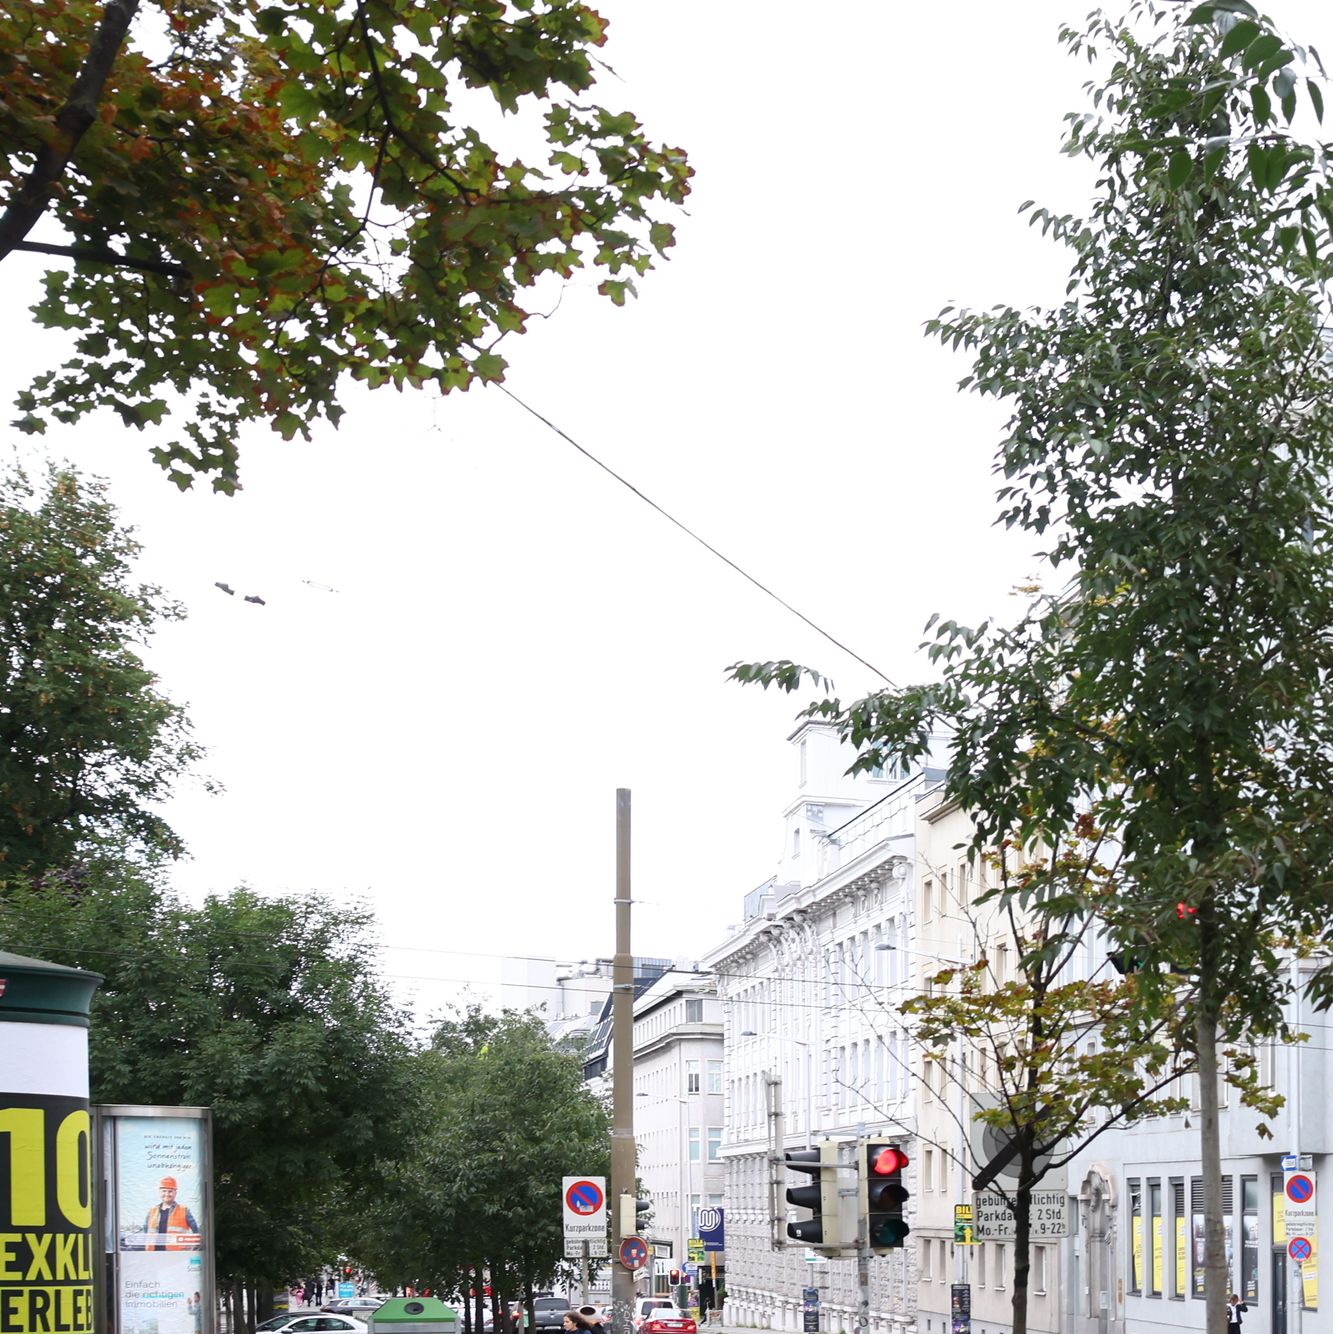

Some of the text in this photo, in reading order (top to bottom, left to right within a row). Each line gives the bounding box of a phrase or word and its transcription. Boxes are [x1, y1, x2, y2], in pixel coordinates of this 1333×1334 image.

[1037, 1210, 1043, 1220] 2
[1046, 1209, 1065, 1220] Std.
[565, 1224, 605, 1233] Kurzparkzone
[125, 1281, 161, 1289] Einfach
